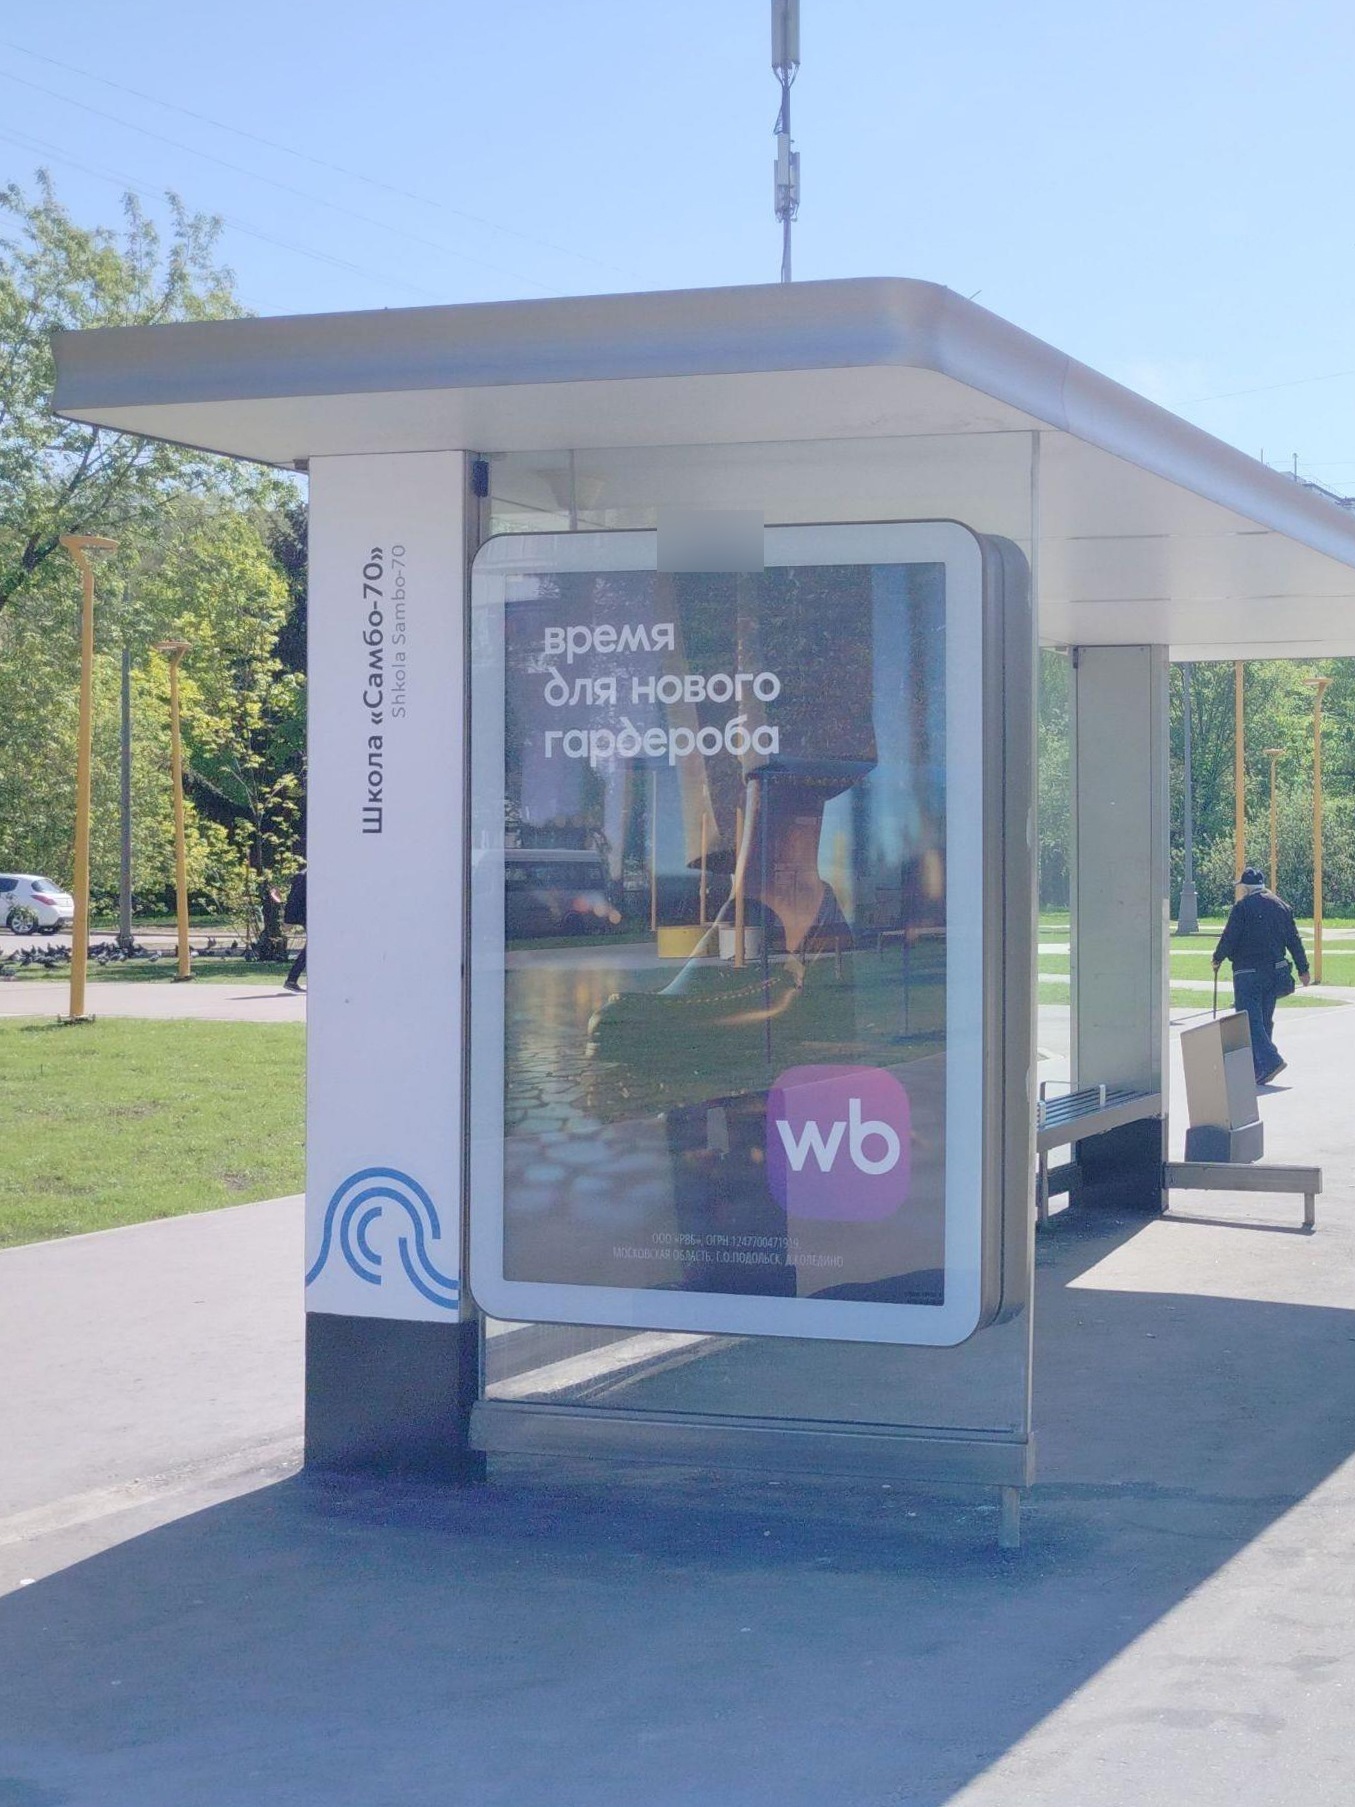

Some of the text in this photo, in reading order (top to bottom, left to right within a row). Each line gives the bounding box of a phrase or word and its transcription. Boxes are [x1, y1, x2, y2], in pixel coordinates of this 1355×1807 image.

[391, 544, 406, 719] Shkola Sambo-70
[544, 622, 675, 664] время
[362, 546, 384, 834] Школа «Самбо-70»
[543, 666, 781, 707] для нового
[544, 714, 780, 768] гардероба
[775, 1098, 901, 1176] wb
[651, 1232, 672, 1245] ООО
